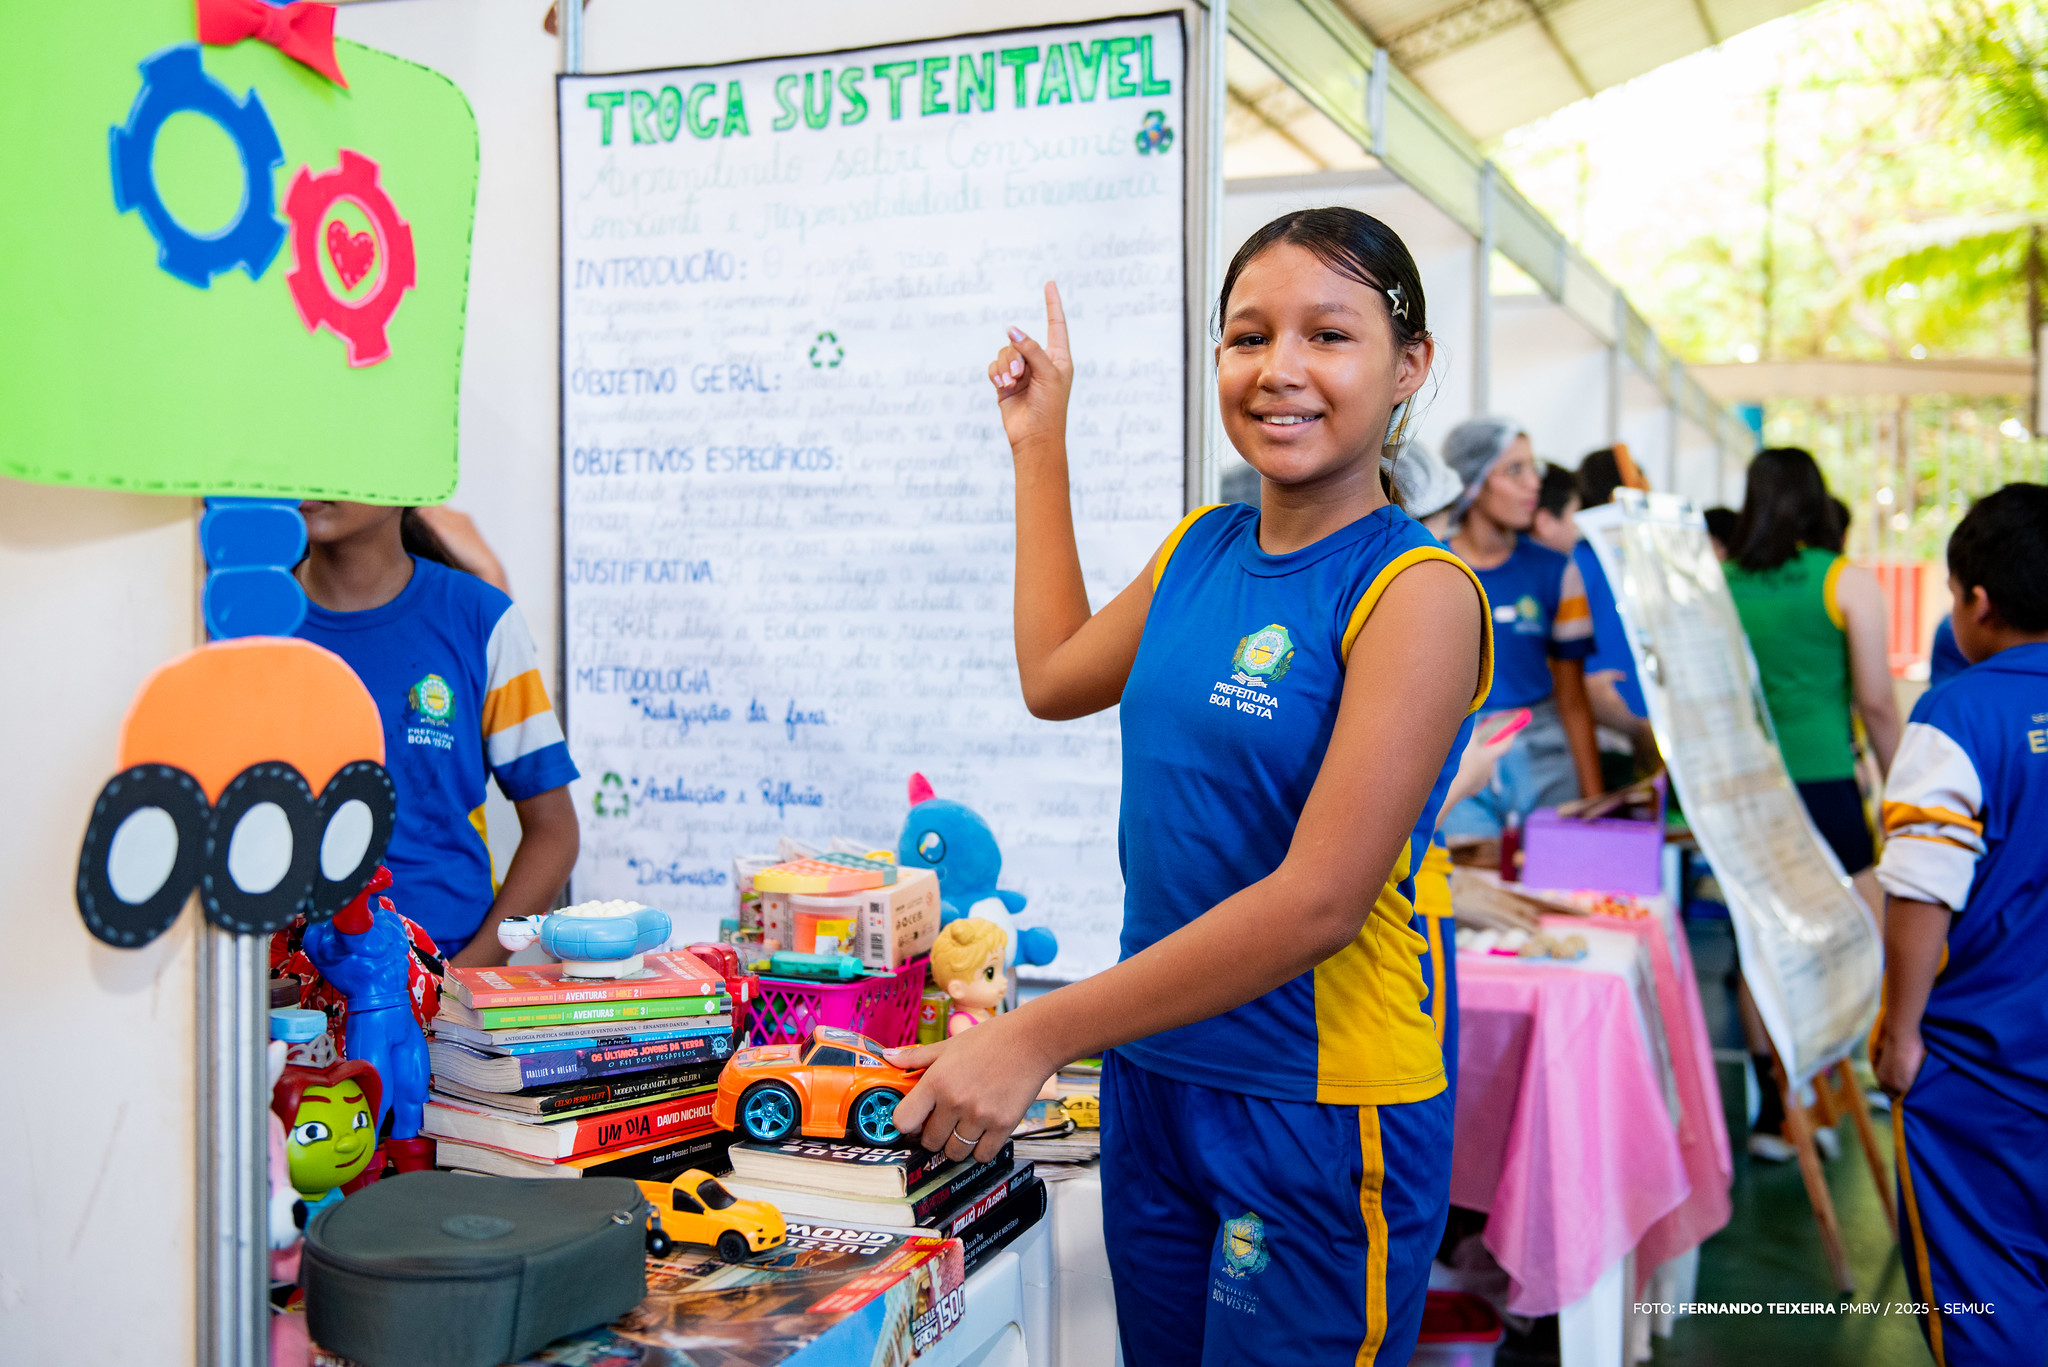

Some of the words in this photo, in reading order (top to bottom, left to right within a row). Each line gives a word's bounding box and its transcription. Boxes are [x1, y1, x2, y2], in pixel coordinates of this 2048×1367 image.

[588, 80, 751, 146] TROCA
[823, 132, 928, 184] sobre
[946, 121, 1127, 170] Consumo
[572, 366, 677, 396] OBJETIVO
[690, 363, 782, 394] GERAL:
[572, 446, 695, 475] OBJETIVOS
[705, 441, 844, 473] ESPECÍFICOS:
[1209, 693, 1231, 708] BOA
[1236, 699, 1273, 720] VISTA
[1213, 681, 1279, 708] PREFEITURA
[407, 727, 455, 742] PREFEITURA
[407, 735, 432, 745] BOA
[565, 990, 607, 1001] AVENTURAS
[615, 988, 633, 998] MIKE
[633, 988, 639, 997] 2
[573, 1007, 614, 1020] AVENTURAS
[622, 1006, 639, 1016] MIKE
[640, 1006, 646, 1016] 3
[504, 1034, 535, 1042] ANTOLOGIA
[591, 1053, 603, 1063] OS
[604, 1048, 639, 1061] ÚLTIMOS
[669, 1041, 680, 1051] DA
[680, 1039, 705, 1050] TERRA
[619, 1058, 632, 1067] REI
[636, 1055, 652, 1063] DOS
[655, 1049, 697, 1061] PESADELOS
[525, 1067, 549, 1079] BRALLIER
[554, 1095, 573, 1108] CELSO
[573, 1093, 591, 1104] PEDRO
[591, 1091, 606, 1102] LUFT
[613, 1084, 640, 1096] MODERNA
[598, 1123, 622, 1146] UM
[656, 1111, 680, 1128] DAVID
[652, 1155, 665, 1164] Como
[665, 1153, 671, 1161] as
[671, 1148, 689, 1159] Pessoas
[689, 1141, 712, 1154] Funcionam
[786, 1223, 894, 1244] GROW
[787, 1237, 880, 1255] PUZZL
[912, 1307, 937, 1331] PUZZLE
[935, 1282, 966, 1334] 1500
[1212, 1288, 1225, 1304] BOA
[1226, 1295, 1257, 1315] VISTA
[914, 1321, 940, 1351] GROW
